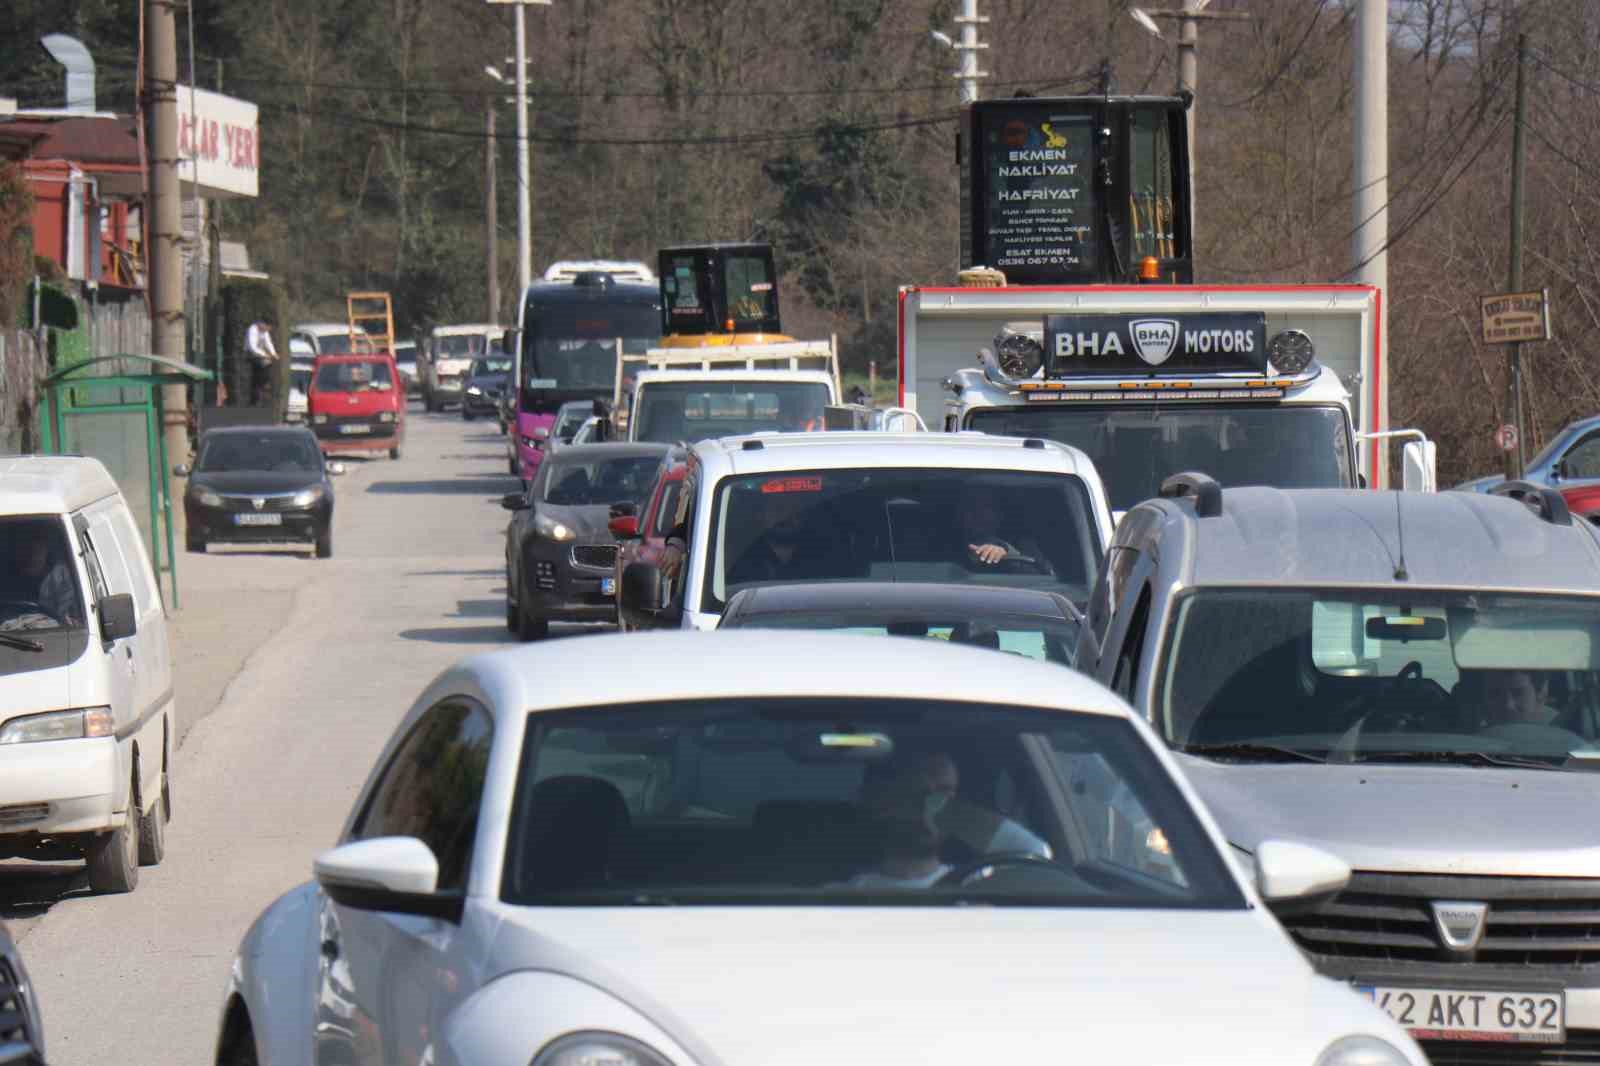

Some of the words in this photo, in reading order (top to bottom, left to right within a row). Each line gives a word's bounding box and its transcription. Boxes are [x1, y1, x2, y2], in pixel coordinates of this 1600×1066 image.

[1008, 150, 1067, 161] EKMEN
[1055, 331, 1125, 357] BHA
[1184, 329, 1255, 354] MOTORS
[1139, 329, 1171, 340] BHA
[1428, 994, 1486, 1027] AKT
[1497, 997, 1558, 1029] 632
